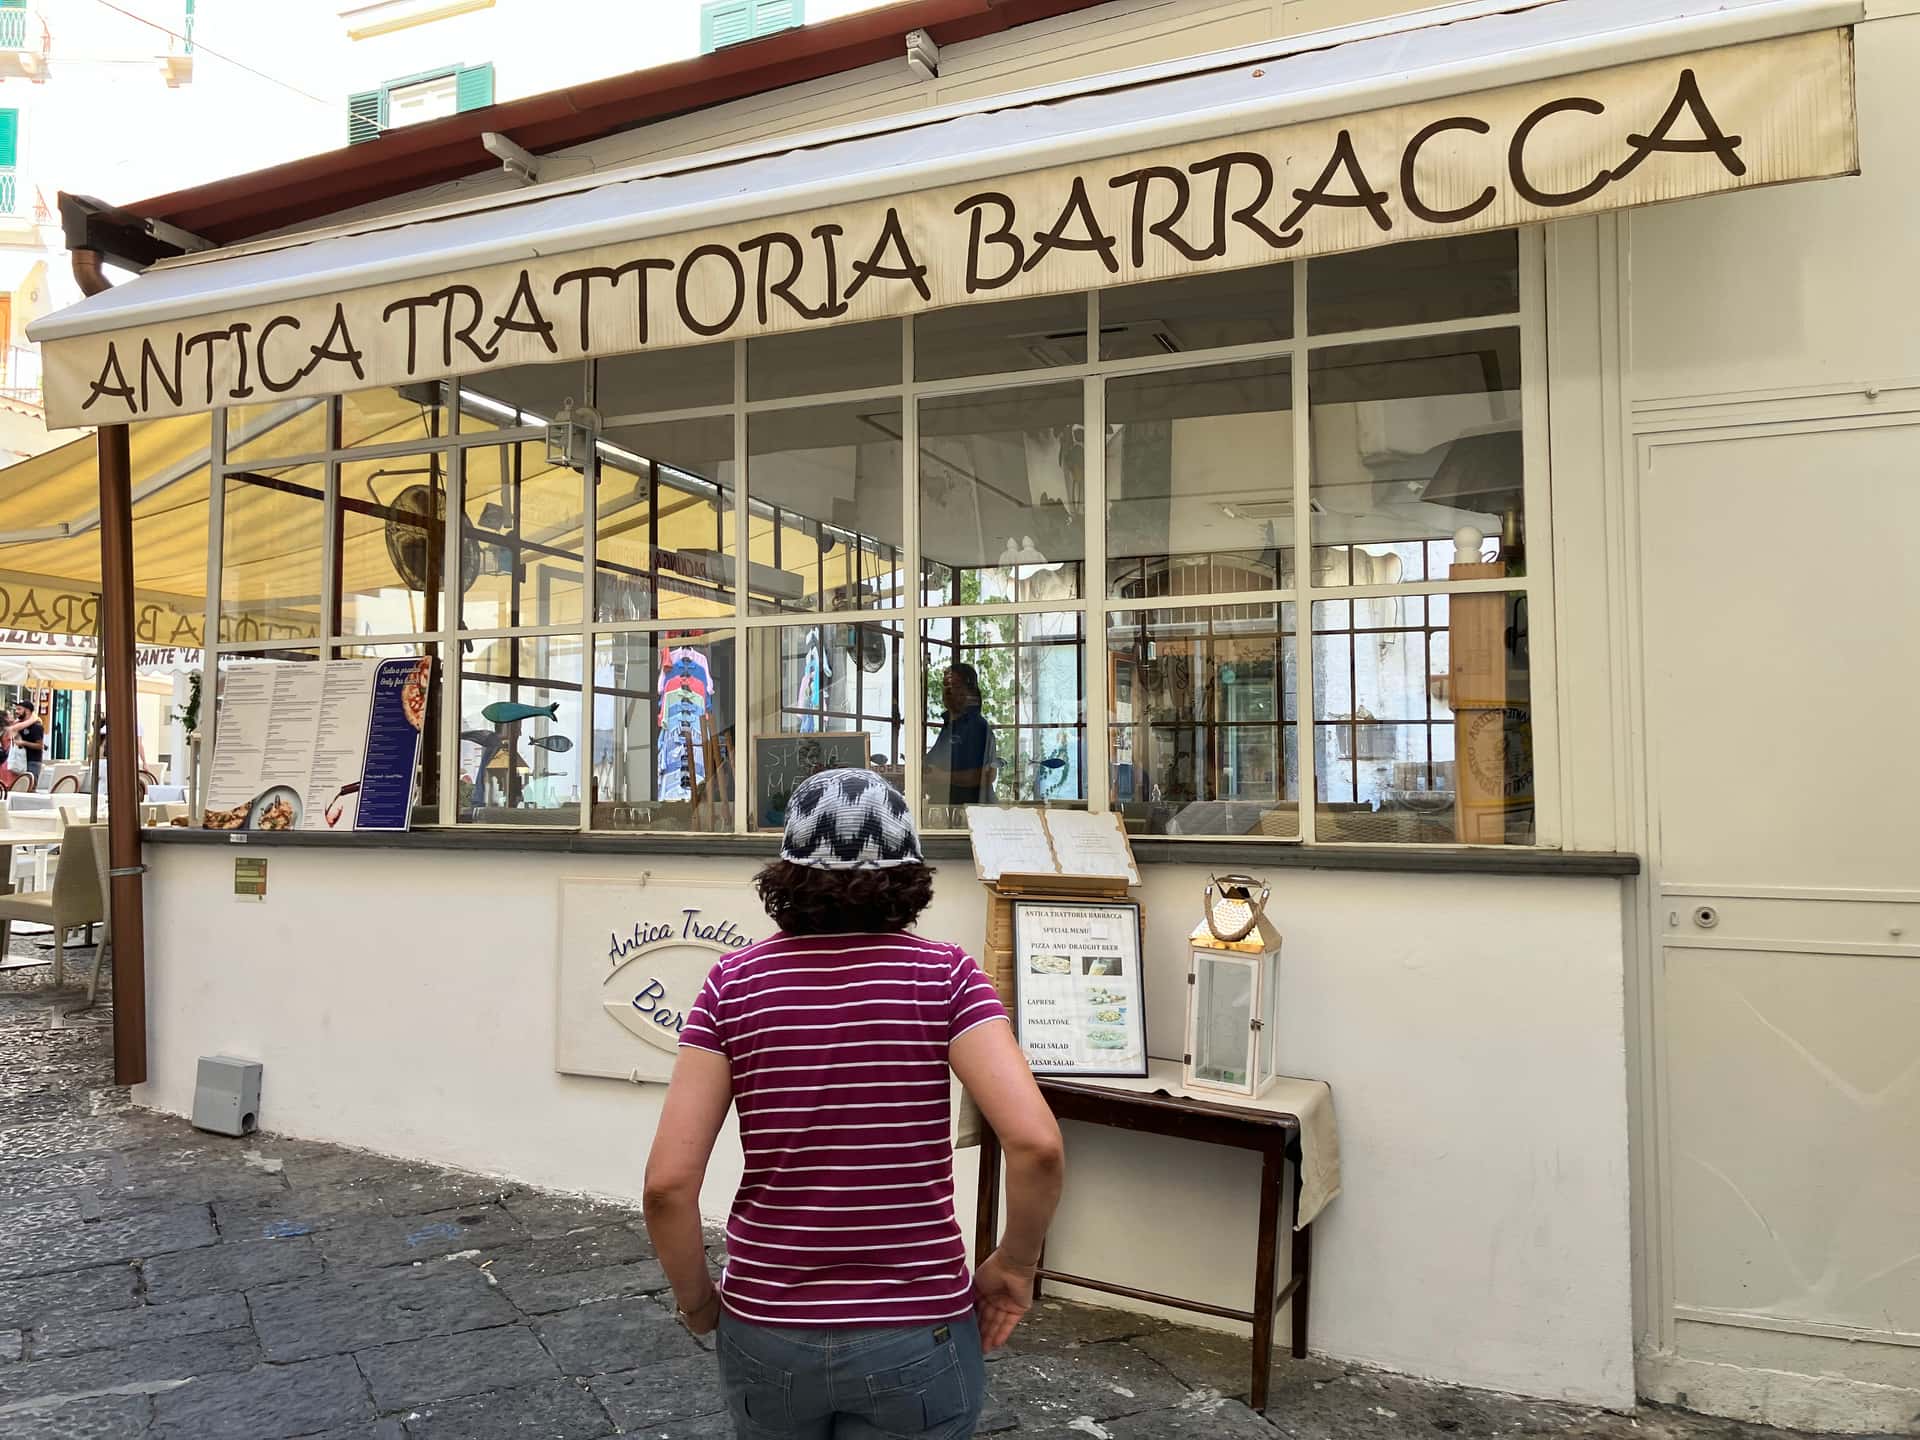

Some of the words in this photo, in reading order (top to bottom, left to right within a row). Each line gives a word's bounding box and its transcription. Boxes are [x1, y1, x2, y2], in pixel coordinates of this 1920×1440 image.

[81, 302, 365, 413] ANTICA
[383, 207, 931, 375] TRATTORIA
[955, 68, 1747, 293] BARRACCA
[1050, 911, 1087, 919] TRATTORIA
[1088, 912, 1122, 920] BARRACCA
[1069, 927, 1089, 935] MENU
[608, 921, 675, 967] Antica
[681, 908, 755, 946] Trattor
[1068, 943, 1100, 951] DRAUGHT
[632, 976, 685, 1033] Bar
